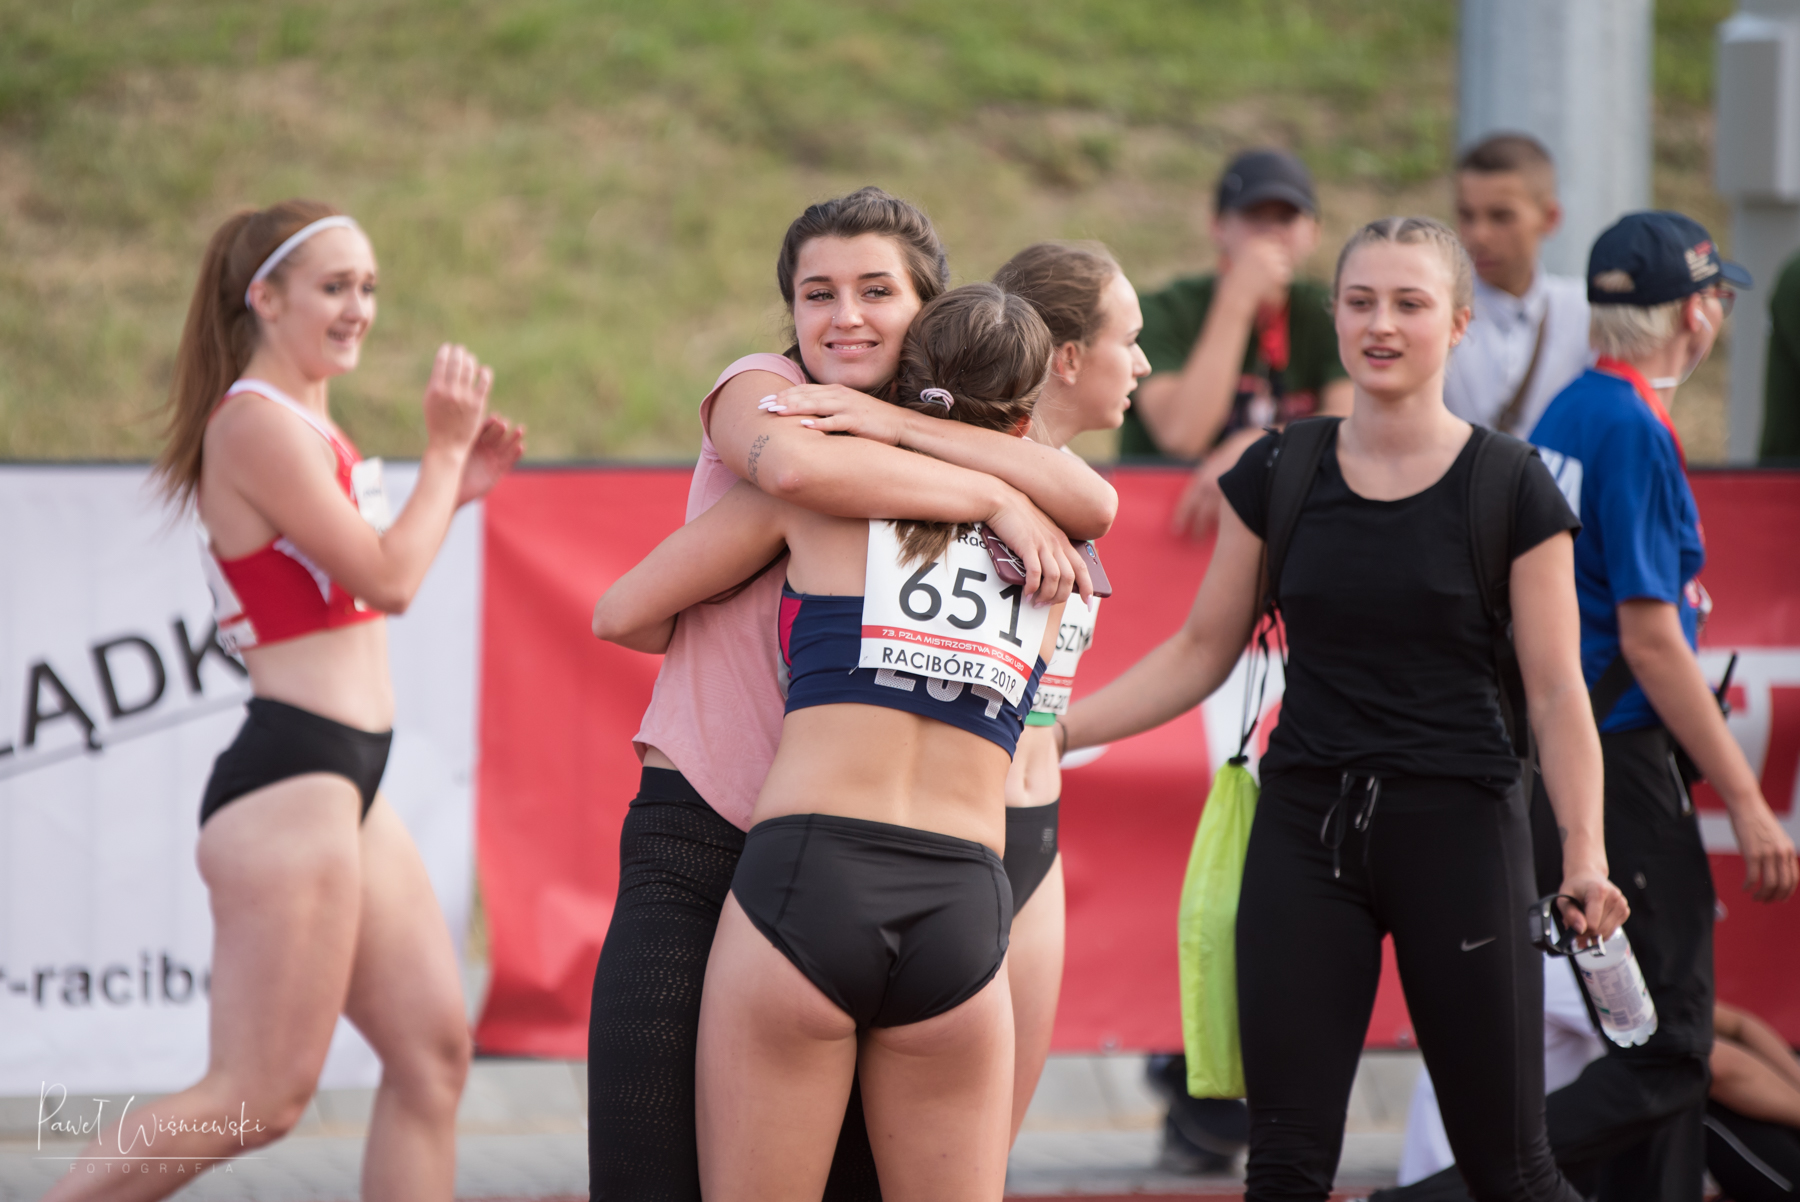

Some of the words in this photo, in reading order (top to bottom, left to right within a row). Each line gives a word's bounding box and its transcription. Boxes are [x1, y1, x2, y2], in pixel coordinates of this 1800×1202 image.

[899, 562, 1023, 649] 651
[882, 628, 897, 638] 73.
[898, 631, 922, 642] PZLA
[923, 636, 991, 655] MISTRZOSTWA
[991, 649, 1015, 665] POLSKI
[882, 646, 985, 680] RACIBÓRZ
[990, 667, 1017, 695] 2019
[0, 616, 250, 755] ĄDK
[0, 950, 212, 1008] -racib
